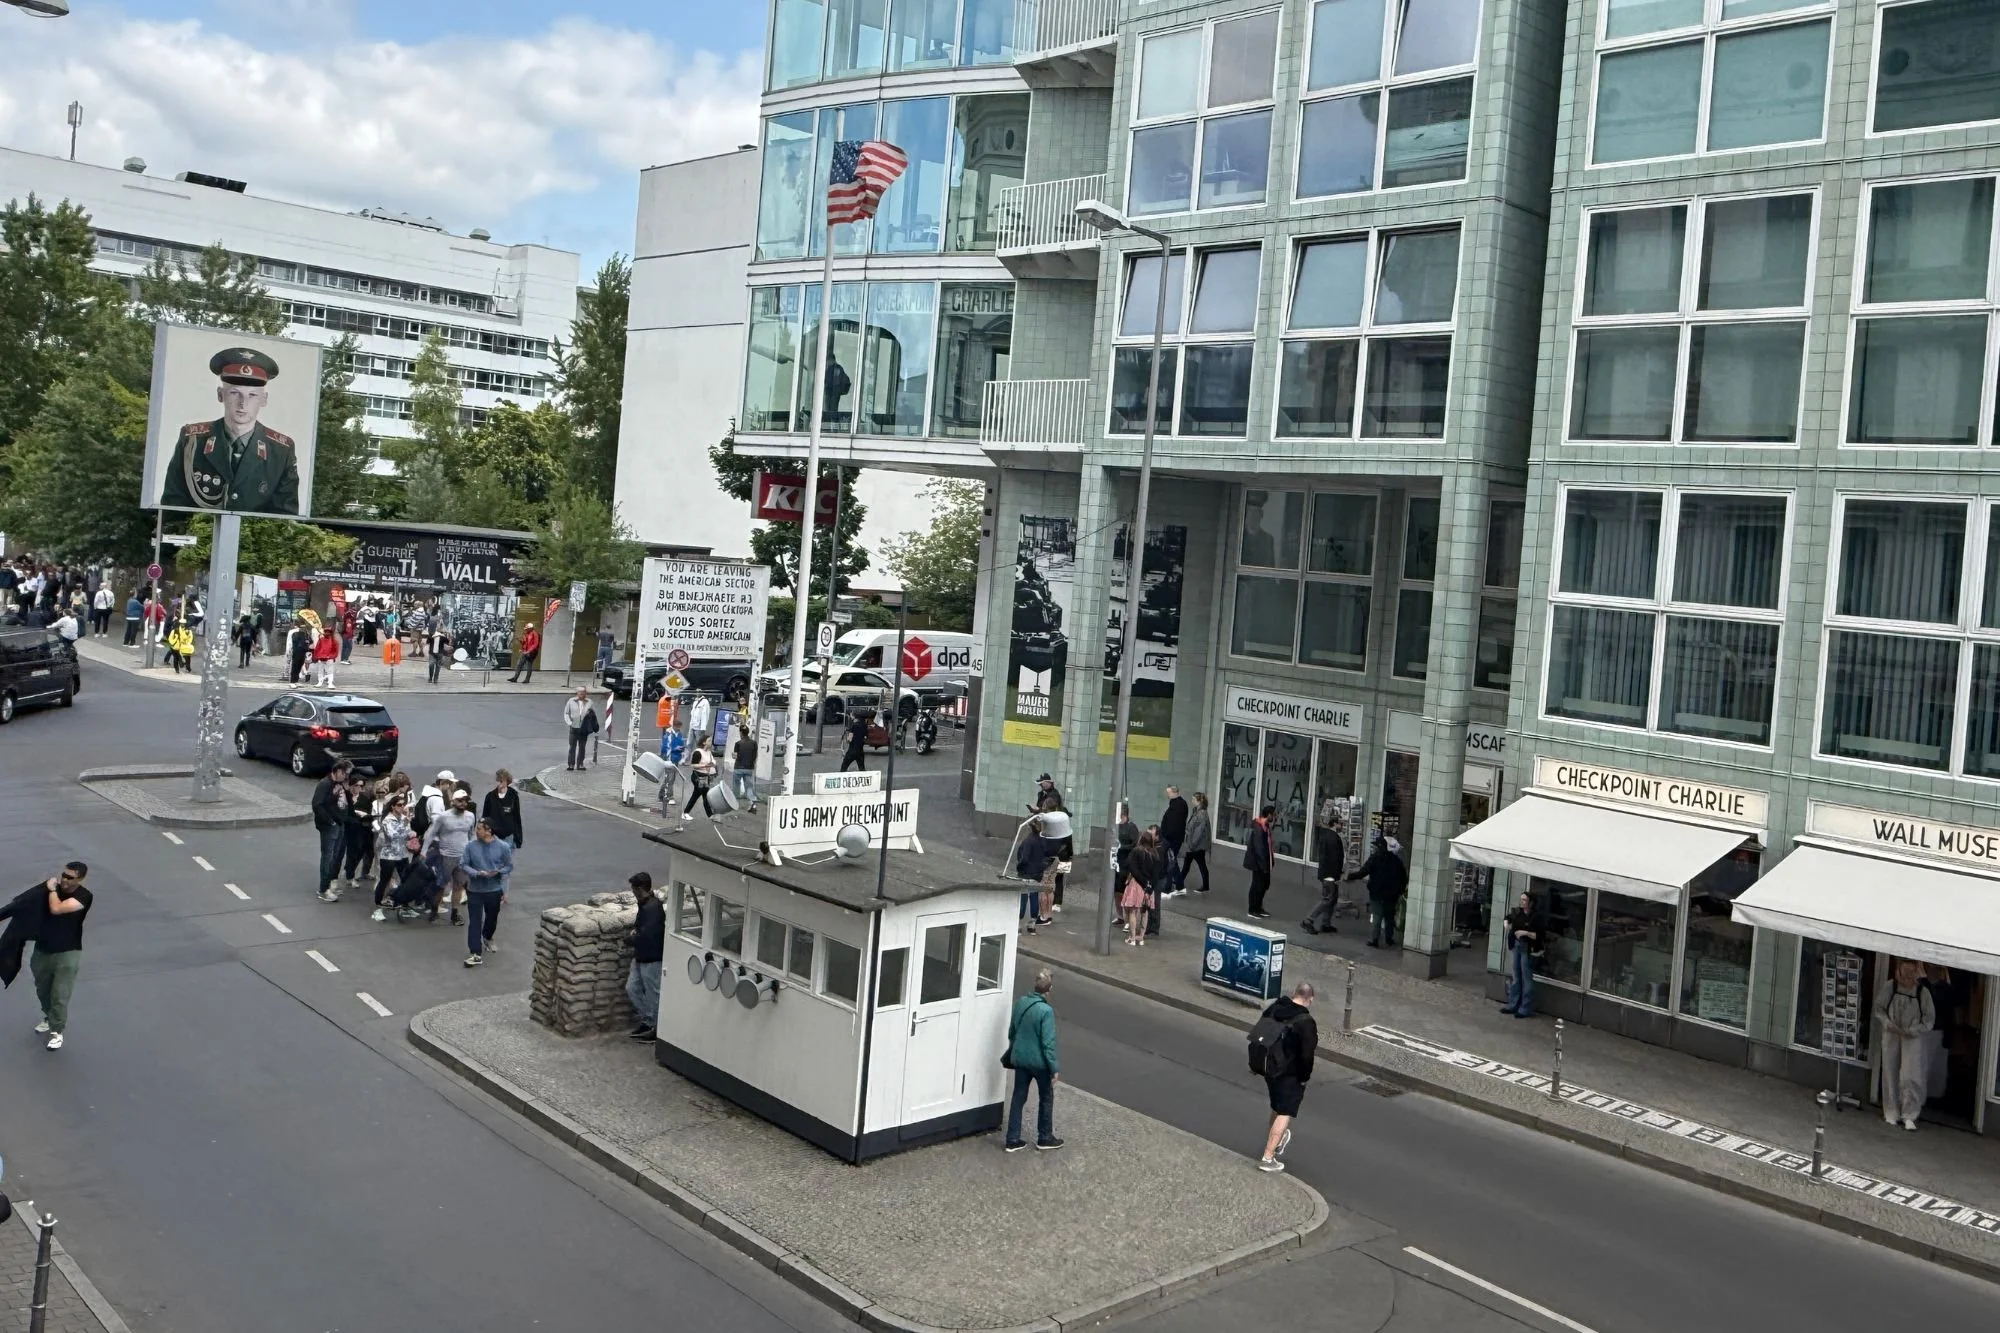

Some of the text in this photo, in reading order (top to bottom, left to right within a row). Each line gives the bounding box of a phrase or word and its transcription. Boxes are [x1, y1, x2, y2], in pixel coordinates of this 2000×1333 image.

[952, 289, 1014, 313] CHARLIE
[367, 546, 416, 559] GUERRE
[441, 562, 496, 584] WALL
[665, 562, 751, 577] YOU ARE LEAVING
[660, 574, 755, 589] THE AMERICAN SECTOR
[668, 617, 735, 629] VOUS SORTEZ
[653, 628, 665, 638] DU
[667, 629, 705, 640] SECTEUR
[938, 646, 970, 671] dpd
[971, 659, 982, 672] 45
[1017, 694, 1049, 706] MAUER
[1016, 705, 1049, 717] MUSEUM
[1238, 697, 1350, 728] CHECKPOINT CHARLIE
[1557, 766, 1745, 816] CHECKPOINT CHARLIE
[803, 806, 837, 828] ARMY
[1873, 819, 1930, 848] WALL
